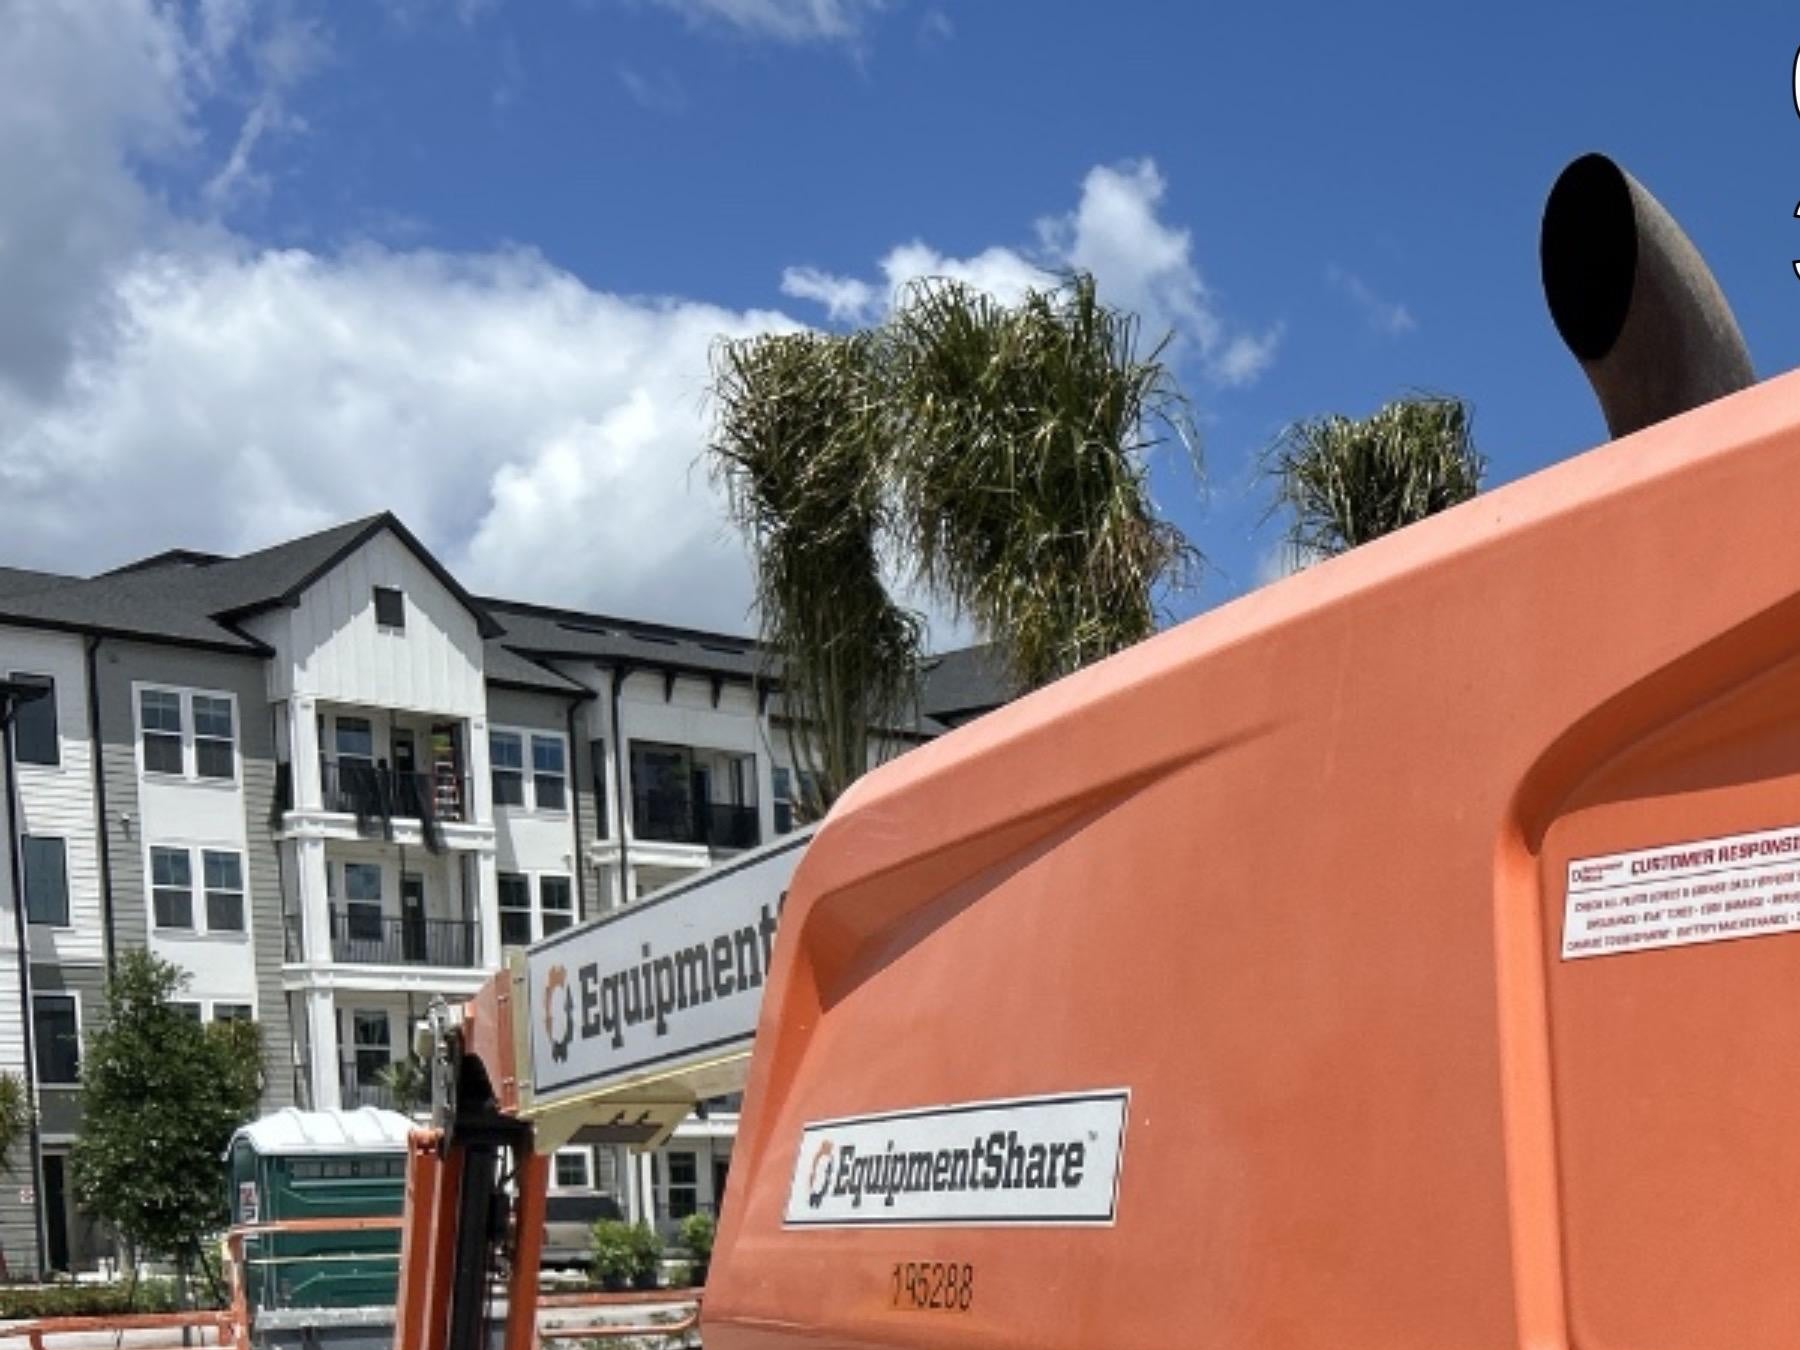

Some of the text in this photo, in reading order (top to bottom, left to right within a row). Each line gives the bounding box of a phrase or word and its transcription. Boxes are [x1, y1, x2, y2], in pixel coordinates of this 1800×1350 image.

[1631, 844, 1716, 875] CUSTOMER
[578, 890, 786, 1049] Equipment
[833, 1129, 1086, 1207] EquipmentShare
[890, 1263, 974, 1312] 195288
